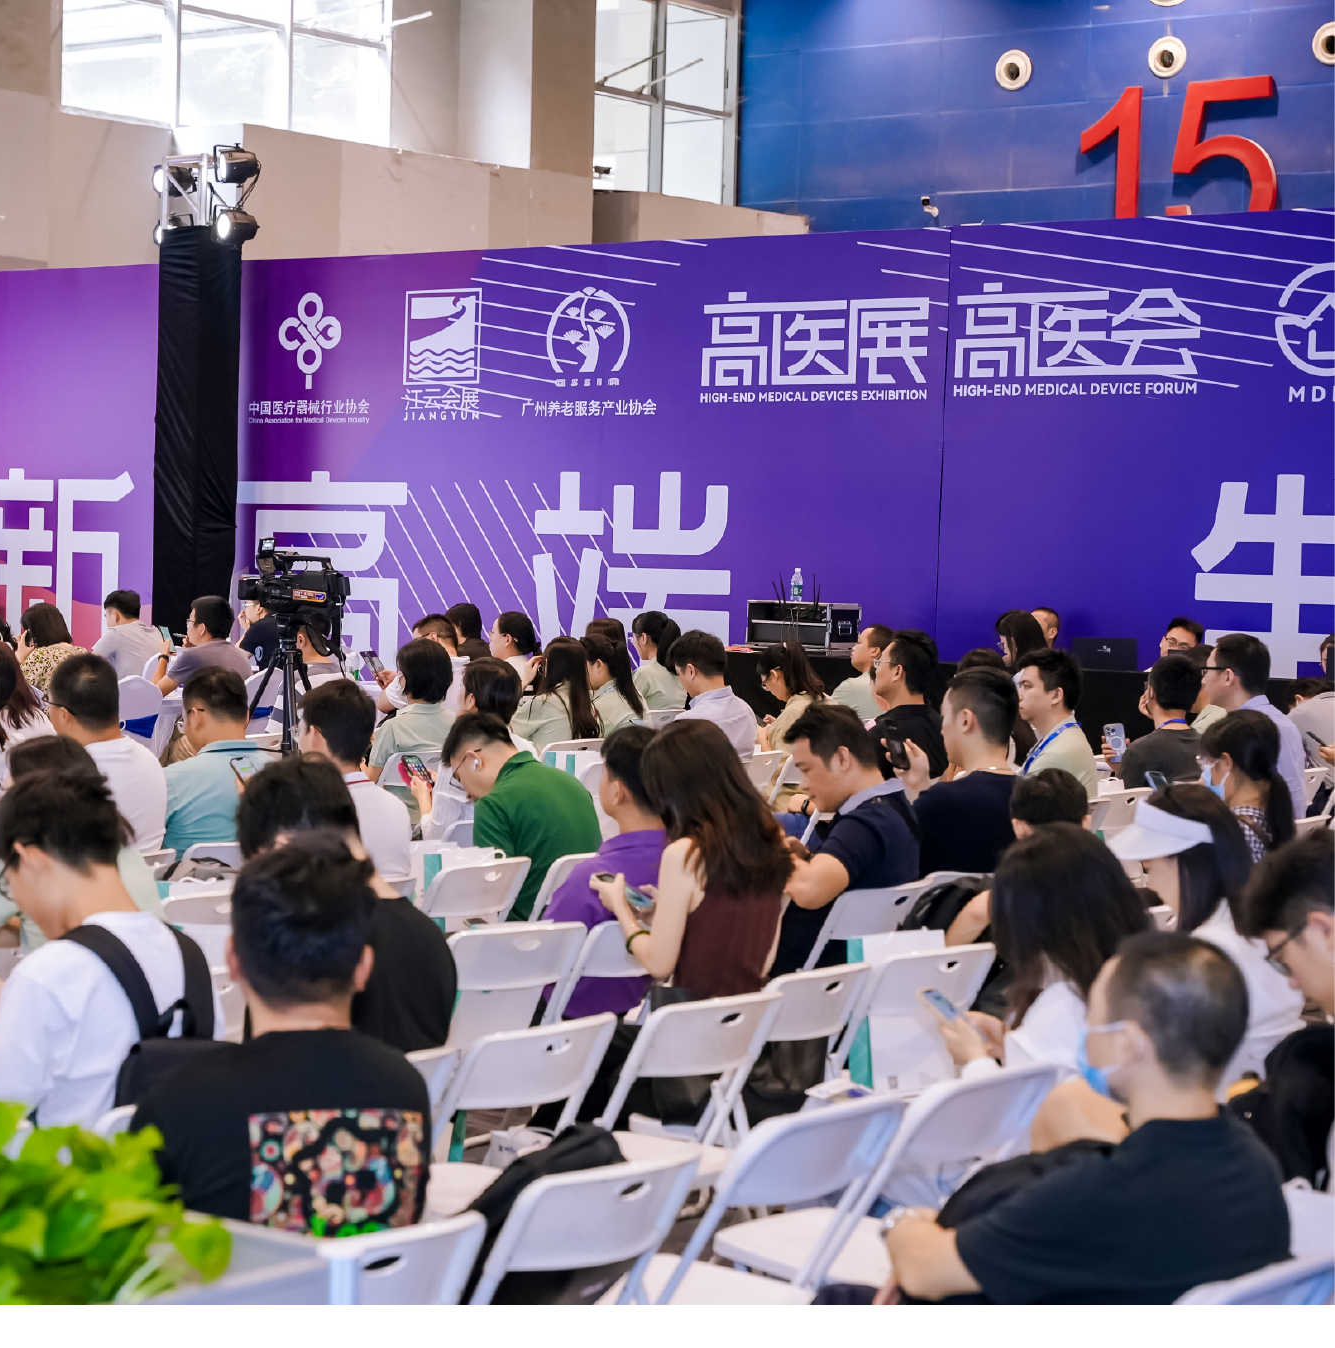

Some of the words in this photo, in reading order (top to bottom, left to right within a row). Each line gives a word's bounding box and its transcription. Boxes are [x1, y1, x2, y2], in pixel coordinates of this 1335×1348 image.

[1080, 75, 1278, 219] 15
[701, 291, 930, 386] 高医展
[953, 281, 1202, 378] 高医会
[699, 392, 756, 403] HIGH-END
[758, 391, 809, 402] MEDICAL
[810, 390, 859, 402] DEVICES
[861, 389, 928, 401] EXHIBITION
[953, 384, 1022, 397] HIGH-END
[1025, 382, 1087, 396] MEDICAL
[1090, 382, 1141, 395] DEVICE
[1145, 381, 1198, 395] FORUM
[1288, 385, 1335, 403] MD
[248, 398, 370, 416] 中国医疗器械行业协会
[404, 387, 479, 411] 江云会展
[521, 398, 657, 417] 广州养老服务产业协会
[347, 416, 370, 425] Industry
[403, 411, 480, 421] JIANGYUN
